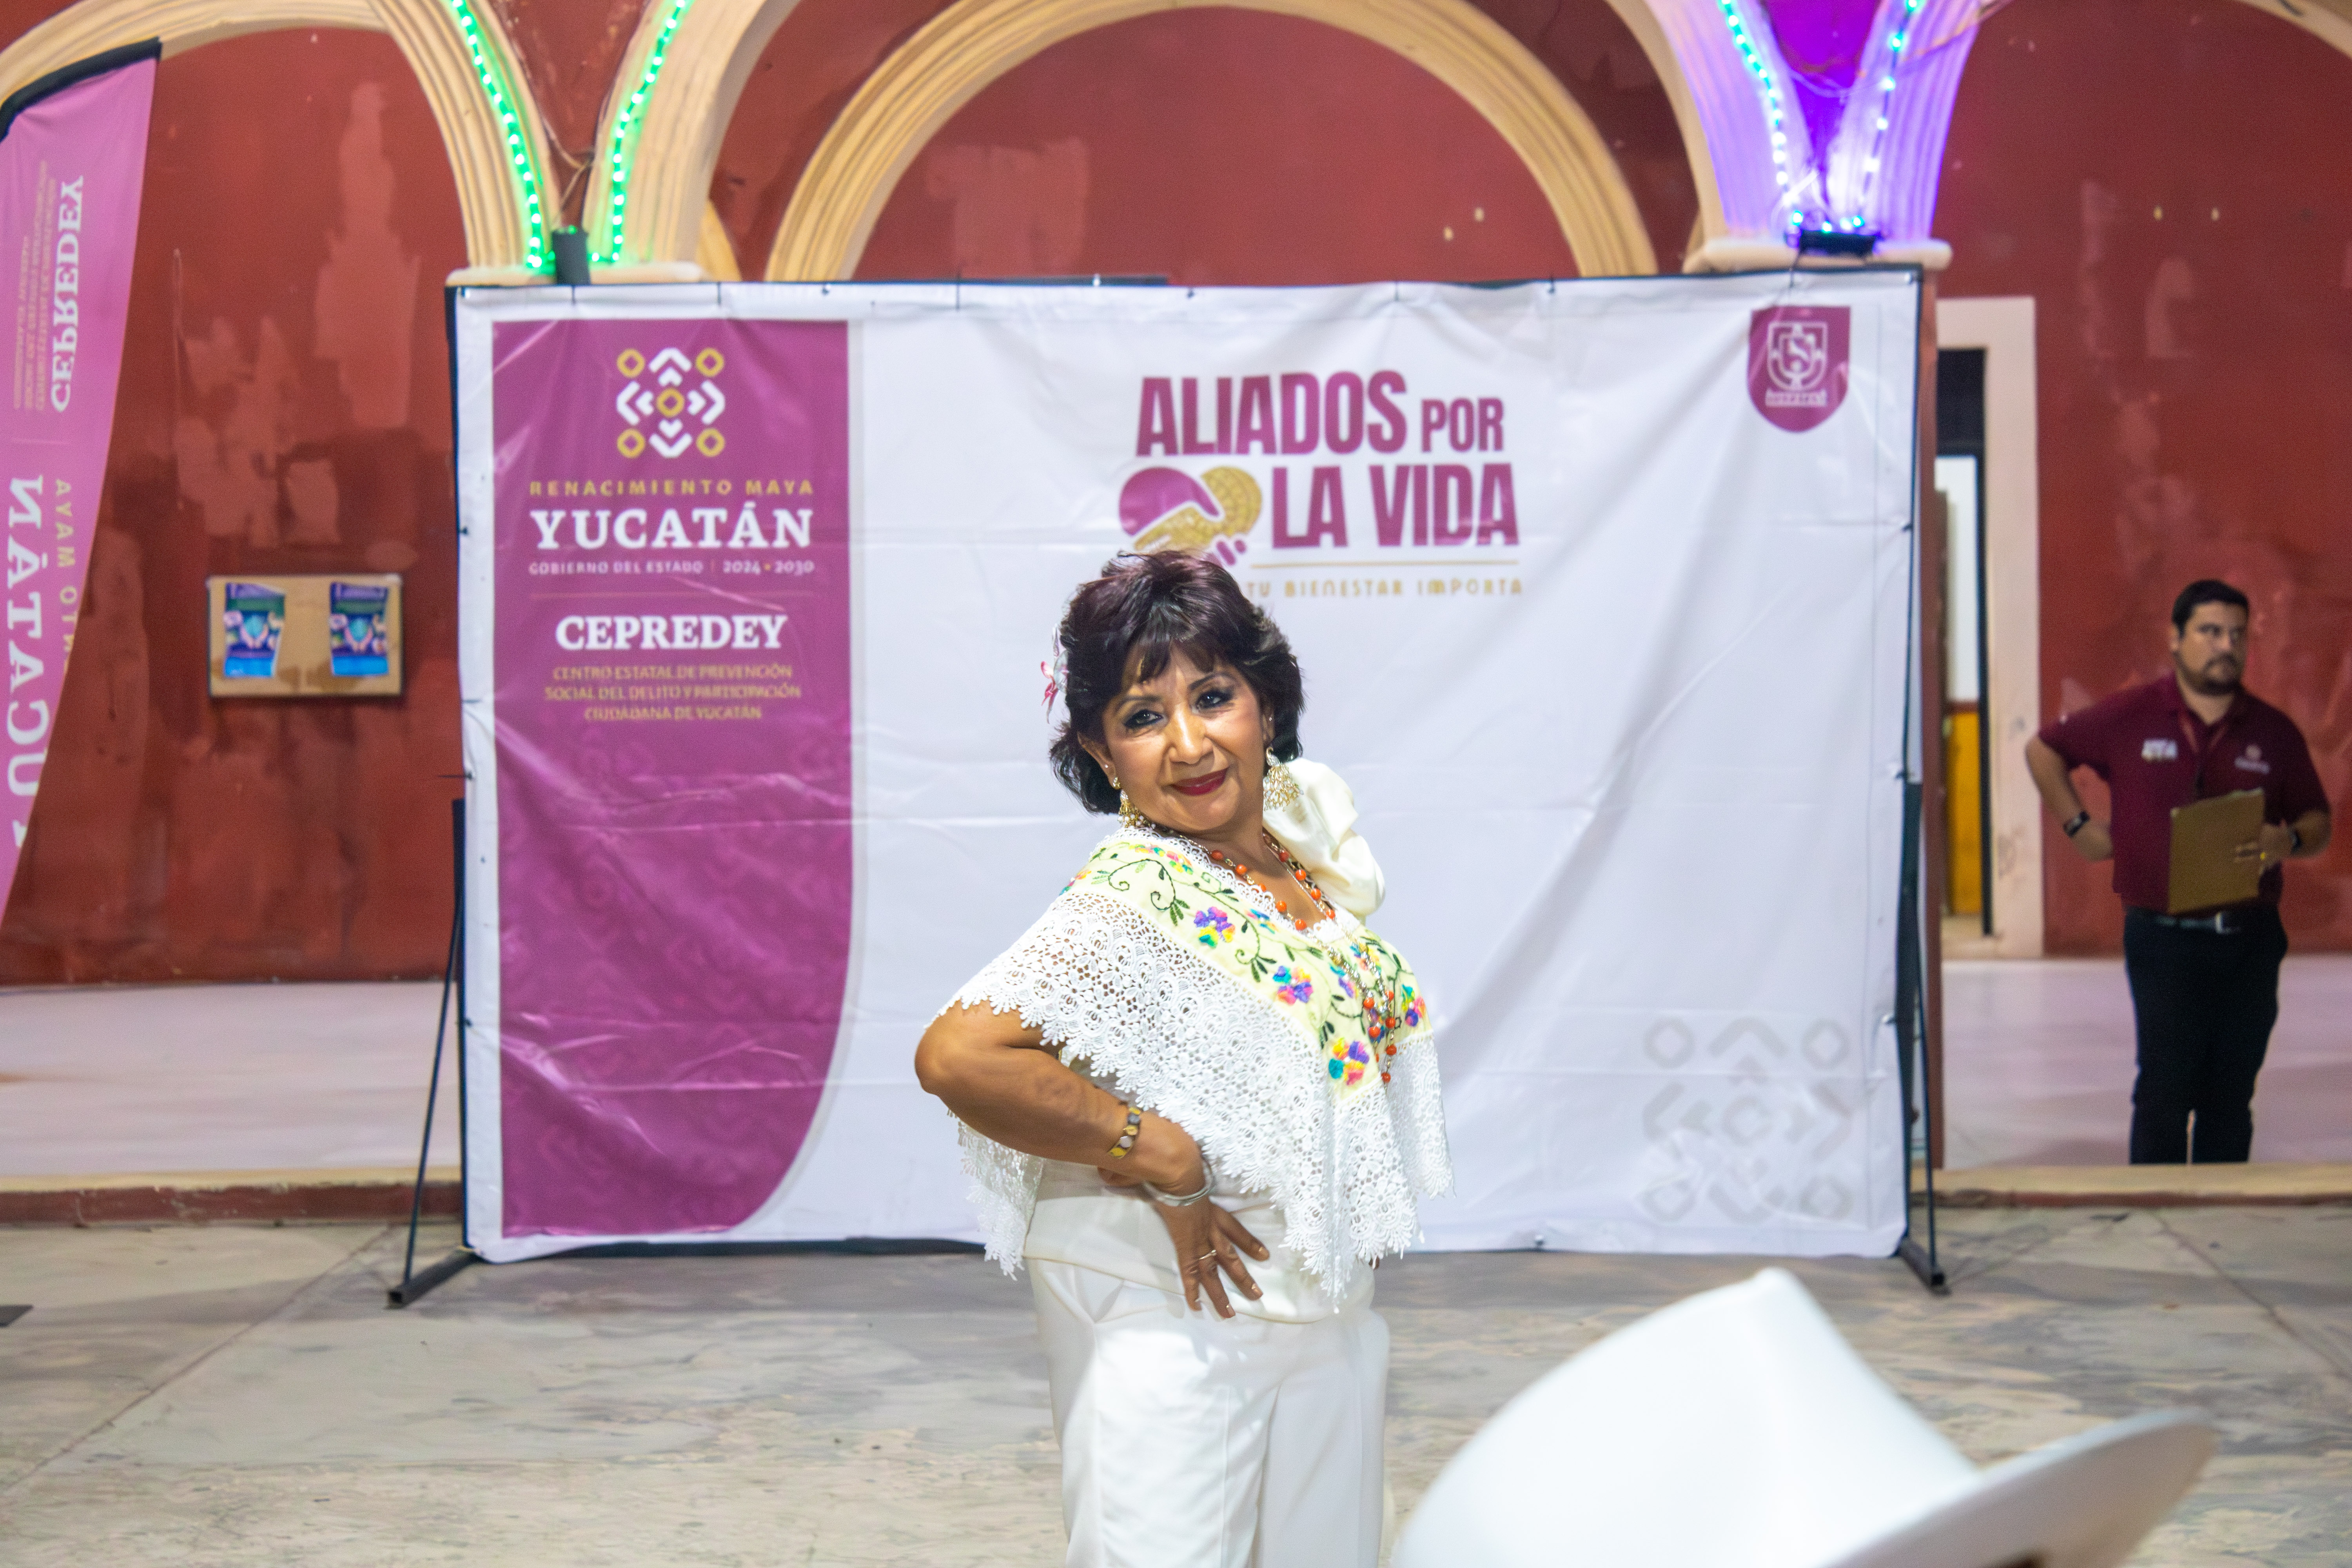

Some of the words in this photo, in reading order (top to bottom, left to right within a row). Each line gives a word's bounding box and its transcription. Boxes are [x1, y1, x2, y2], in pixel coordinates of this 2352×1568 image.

[1136, 370, 1407, 456] ALIADOS
[1421, 397, 1504, 453] POR
[530, 479, 732, 496] RENACIMIENTO
[746, 479, 813, 495] MAYA
[1272, 465, 1348, 548] LA
[1368, 463, 1519, 546] VIDA
[530, 501, 813, 549] YUCATÁN
[529, 561, 608, 575] GOBIERNO
[613, 561, 641, 574] DEL
[646, 560, 704, 574] ESTADO
[1246, 581, 1270, 597] TU
[1284, 579, 1403, 598] BIENESTAR
[1417, 578, 1523, 596] IMPORTA
[556, 614, 788, 650] CEPREDEY
[553, 666, 612, 681] CENTRO
[615, 665, 674, 680] ESTATAL
[677, 666, 695, 679] DE
[699, 663, 792, 679] PREVENCIÓN
[544, 686, 593, 701] SOCIAL
[599, 686, 624, 700] DEL
[629, 685, 681, 699] DELITO
[696, 704, 761, 719] YUCATÁN
